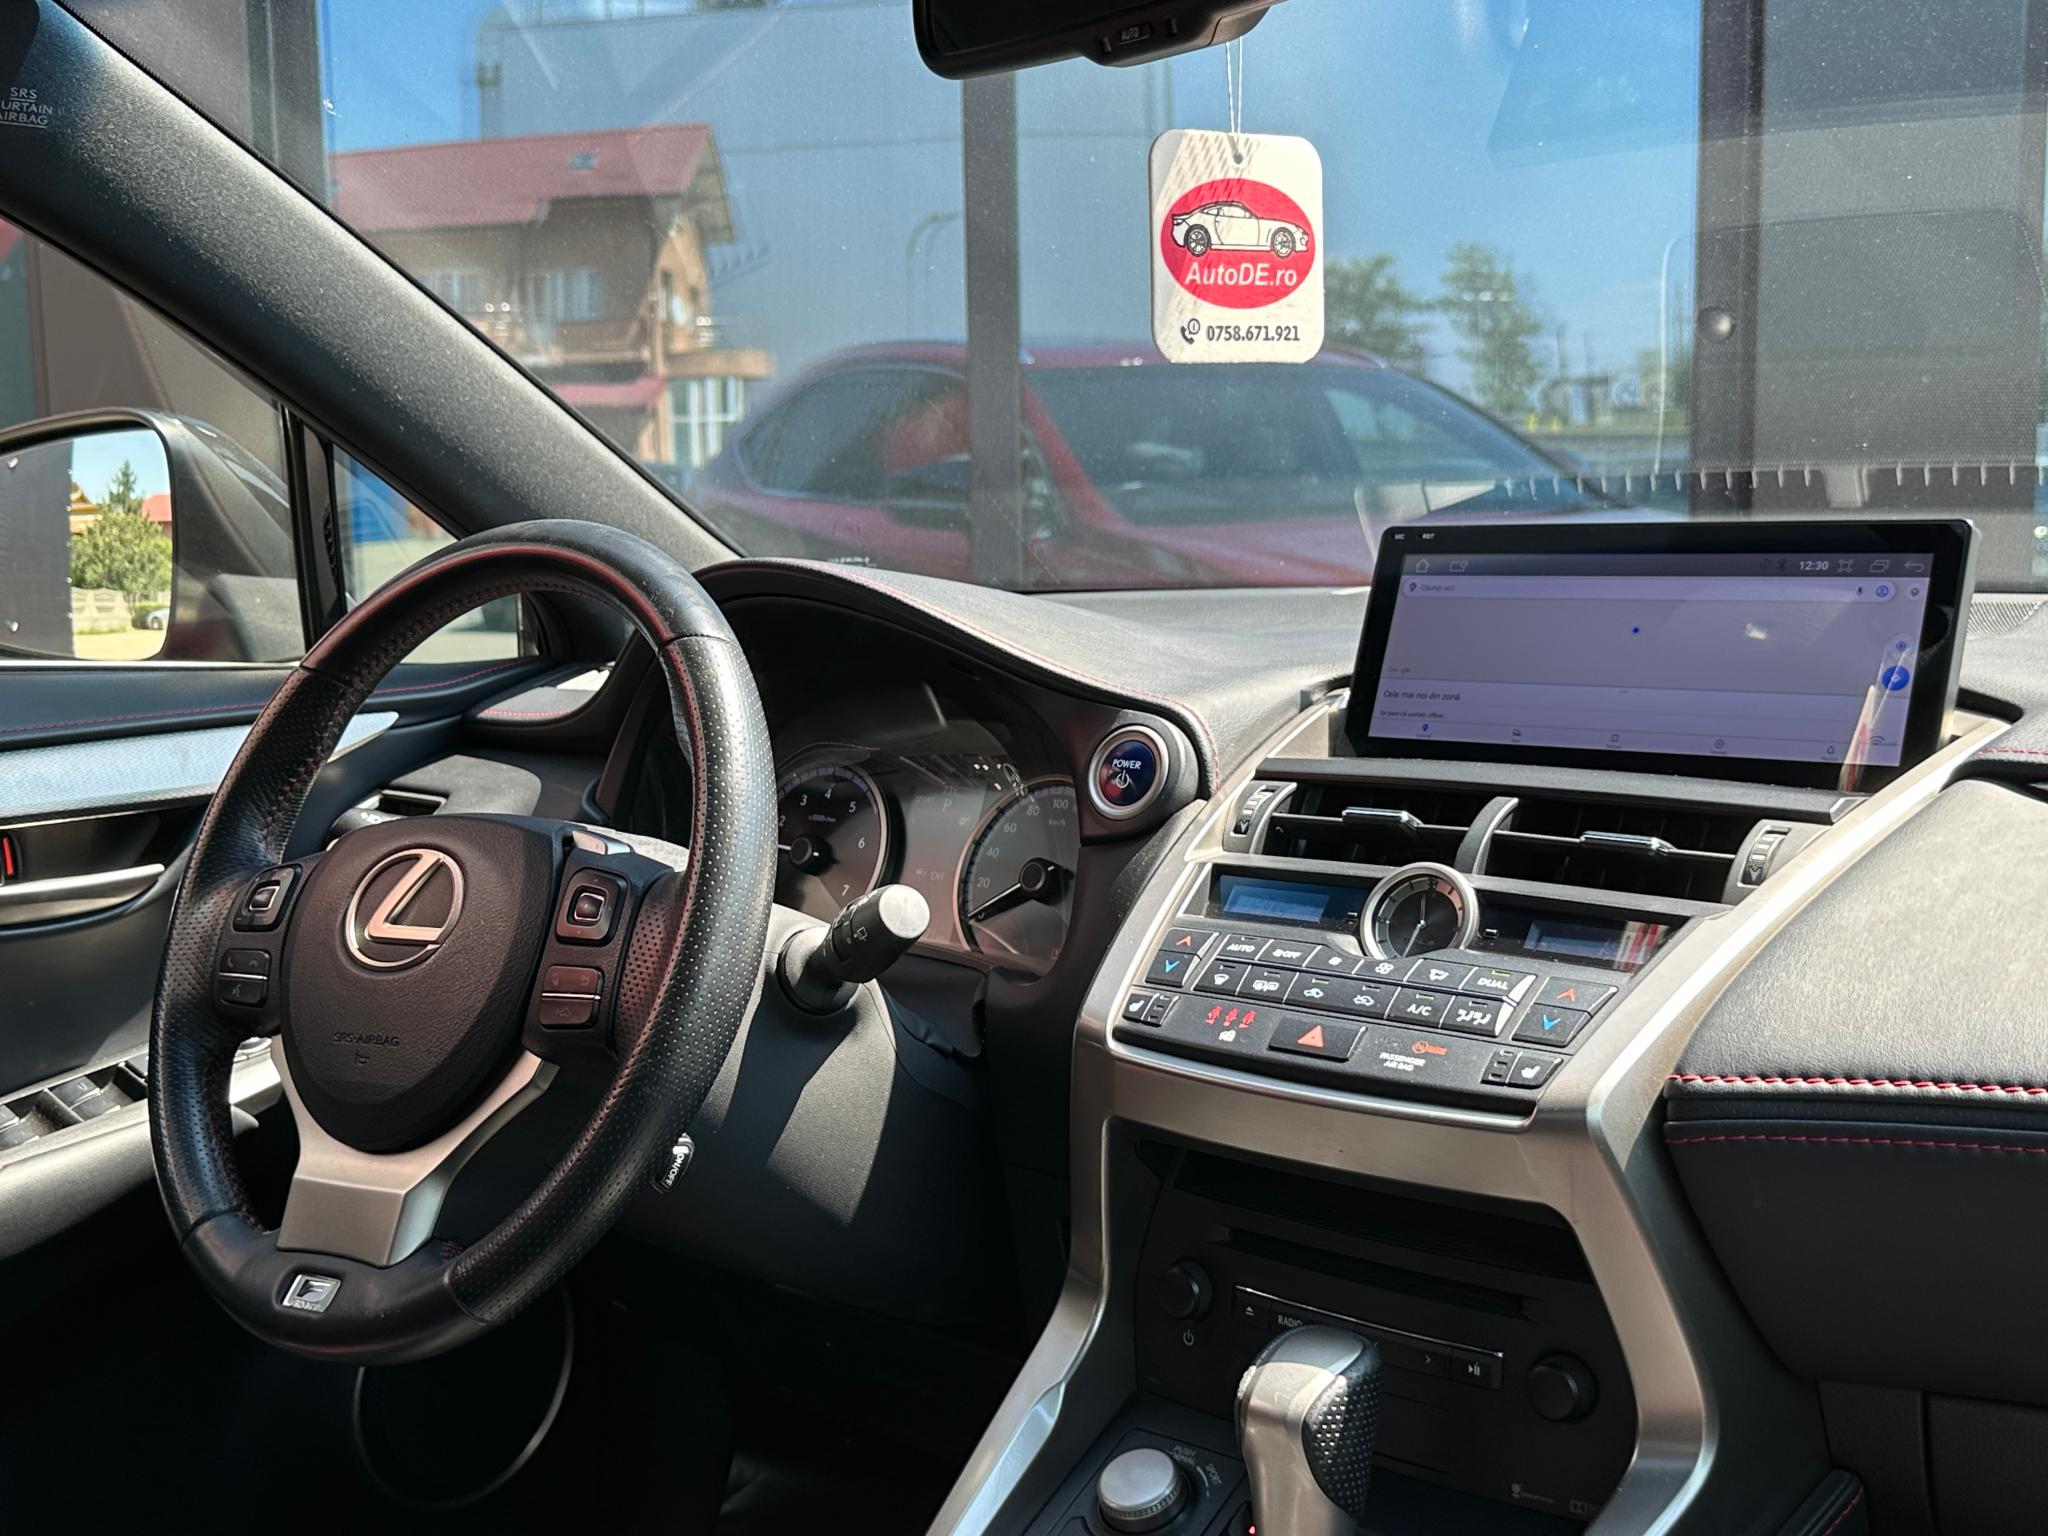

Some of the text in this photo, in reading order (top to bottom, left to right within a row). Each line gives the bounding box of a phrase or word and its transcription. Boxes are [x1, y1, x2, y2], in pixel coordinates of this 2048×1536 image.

[10, 86, 37, 99] SRS
[0, 100, 53, 115] URTAIN
[1184, 262, 1297, 287] AutoDE.ro
[1206, 325, 1300, 342] 0758.671.921
[1799, 560, 1829, 571] 12:30
[1111, 758, 1142, 770] POWER
[800, 794, 808, 806] 3
[1052, 799, 1069, 809] 100
[848, 801, 857, 813] 5
[1026, 805, 1040, 816] 80
[1003, 822, 1017, 833] 60
[858, 837, 866, 849] 6
[986, 847, 1000, 858] 40
[976, 877, 991, 888] 20
[841, 884, 850, 896] 7
[1227, 943, 1255, 953] AUTO
[1477, 977, 1509, 990] DUAL
[1407, 1005, 1432, 1016] A/C
[666, 1153, 685, 1186] ON/OFF
